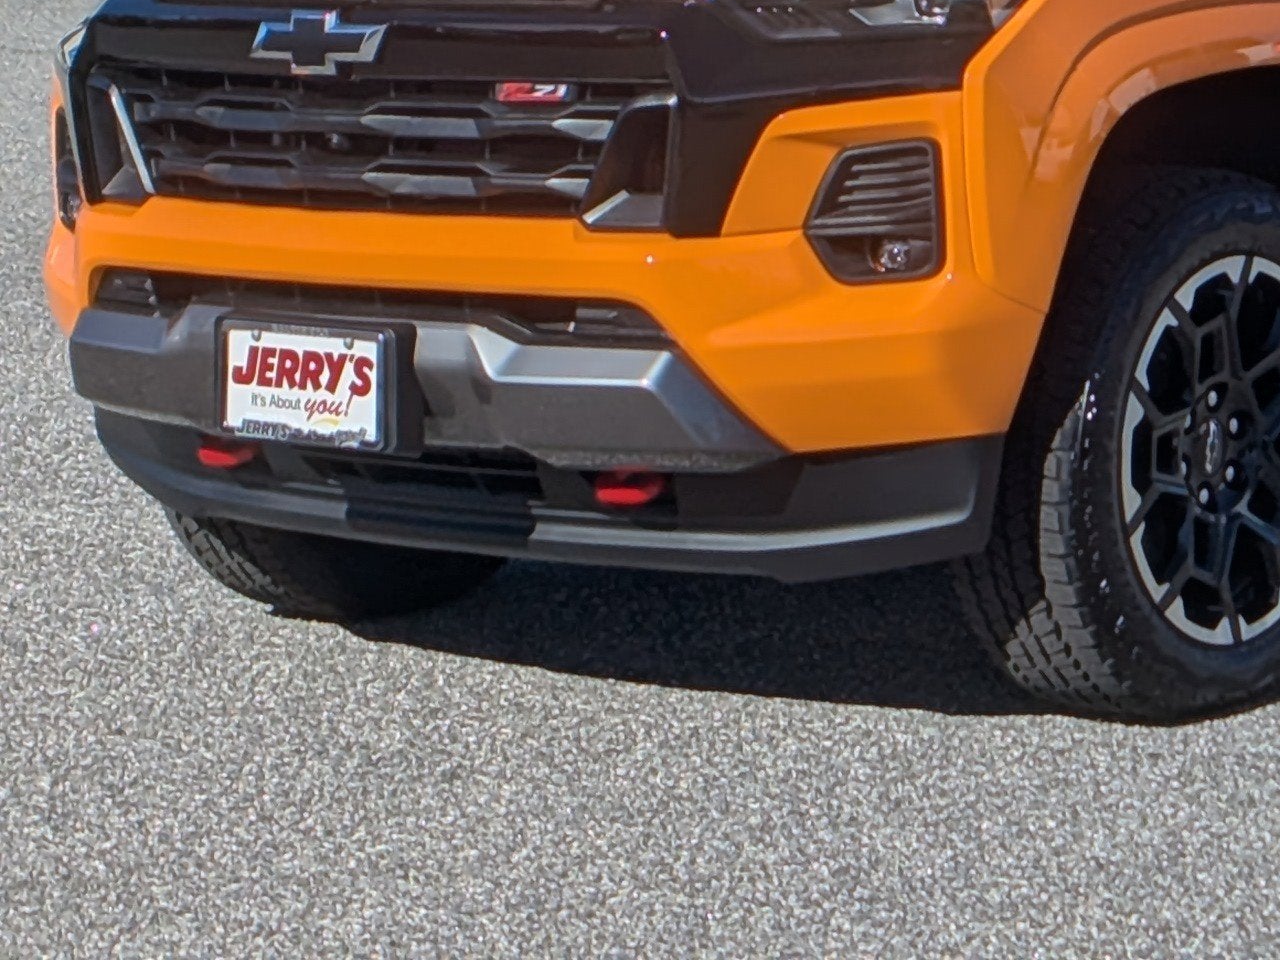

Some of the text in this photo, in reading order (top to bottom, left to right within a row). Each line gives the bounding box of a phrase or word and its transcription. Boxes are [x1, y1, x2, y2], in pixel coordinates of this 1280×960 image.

[232, 345, 374, 397] JERRY'S
[269, 394, 301, 411] About
[303, 391, 354, 421] you!
